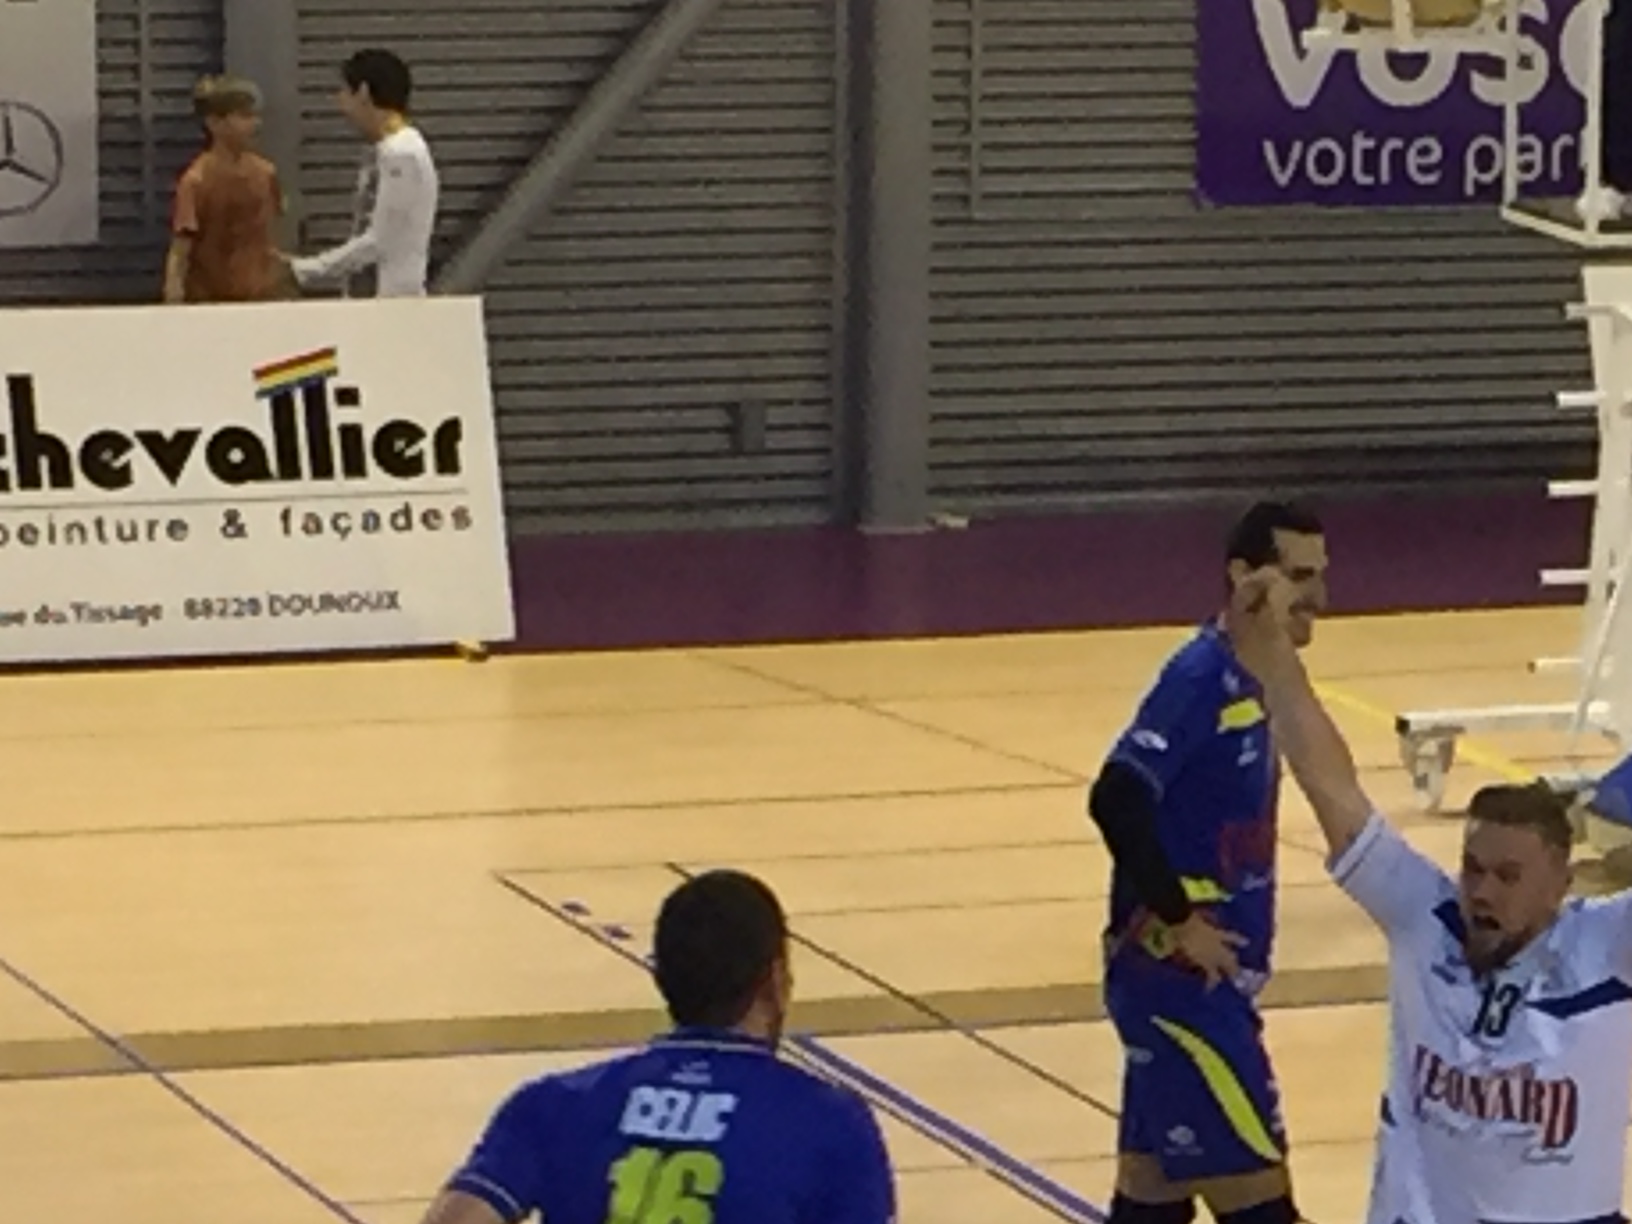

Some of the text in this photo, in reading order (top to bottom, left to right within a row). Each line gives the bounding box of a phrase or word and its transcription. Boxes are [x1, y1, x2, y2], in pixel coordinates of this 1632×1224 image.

[1262, 130, 1443, 188] votre
[0, 372, 464, 497] hevallier
[220, 509, 248, 539] &
[280, 501, 473, 539] façades
